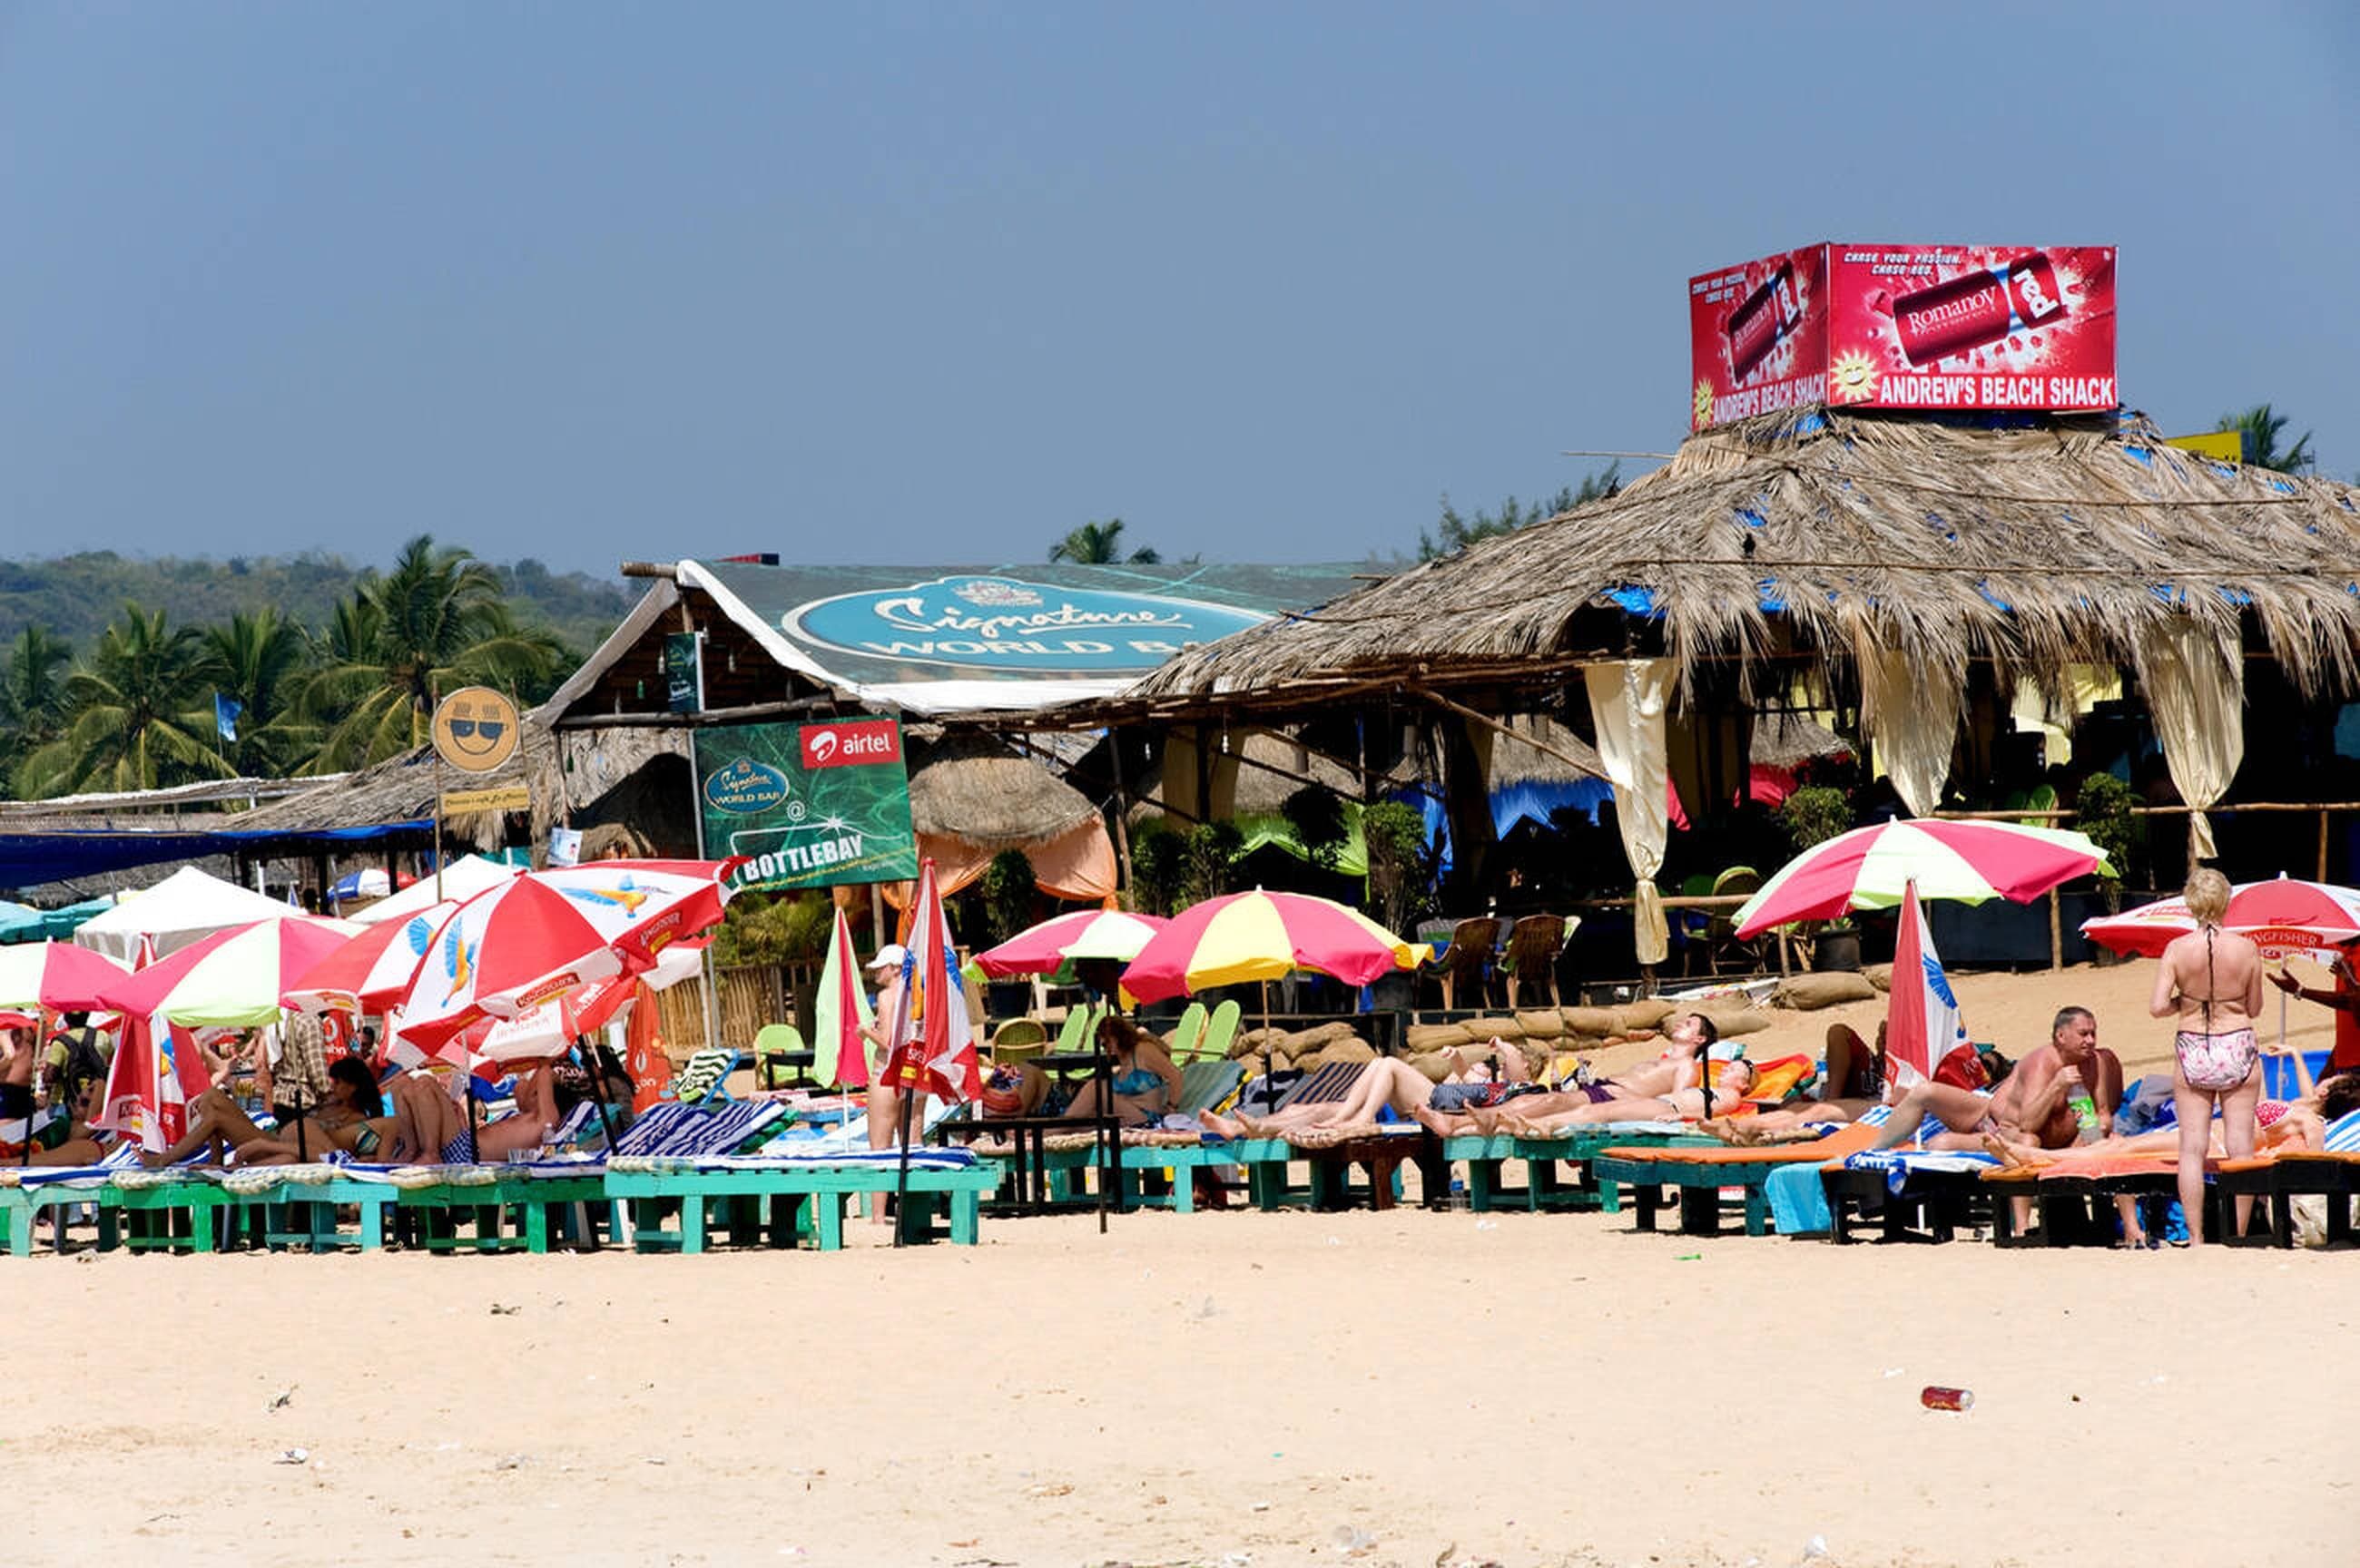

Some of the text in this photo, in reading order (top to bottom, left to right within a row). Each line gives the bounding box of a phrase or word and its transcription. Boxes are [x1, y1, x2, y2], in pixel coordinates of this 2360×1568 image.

[1880, 376, 2114, 406] ANDREW'S BEACH SHACK
[874, 597, 1185, 637] Signature
[861, 640, 1114, 654] WORLD
[842, 733, 891, 754] airtel
[743, 835, 861, 882] BOTTLEBAY
